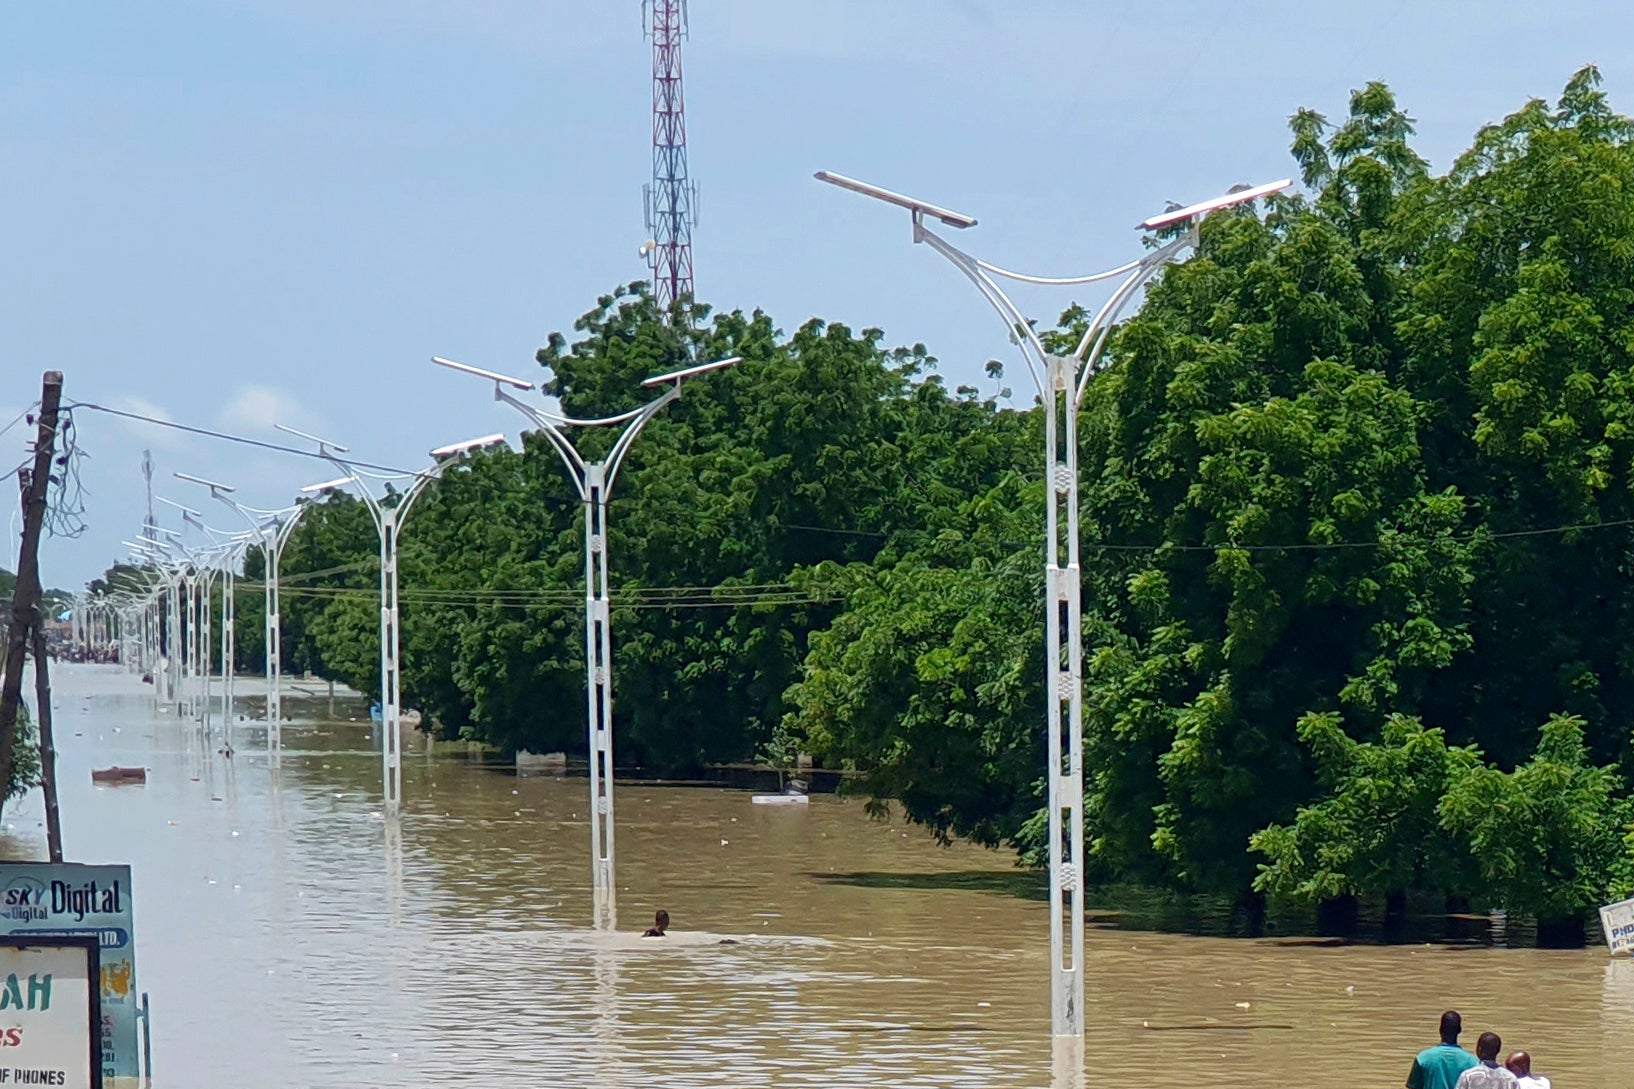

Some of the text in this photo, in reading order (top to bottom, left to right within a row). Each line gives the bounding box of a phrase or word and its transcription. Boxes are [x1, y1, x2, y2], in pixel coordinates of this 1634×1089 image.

[5, 884, 46, 905] SKY
[51, 880, 124, 922] Digital
[11, 907, 49, 923] Digital
[0, 1068, 66, 1086] F PHONES
